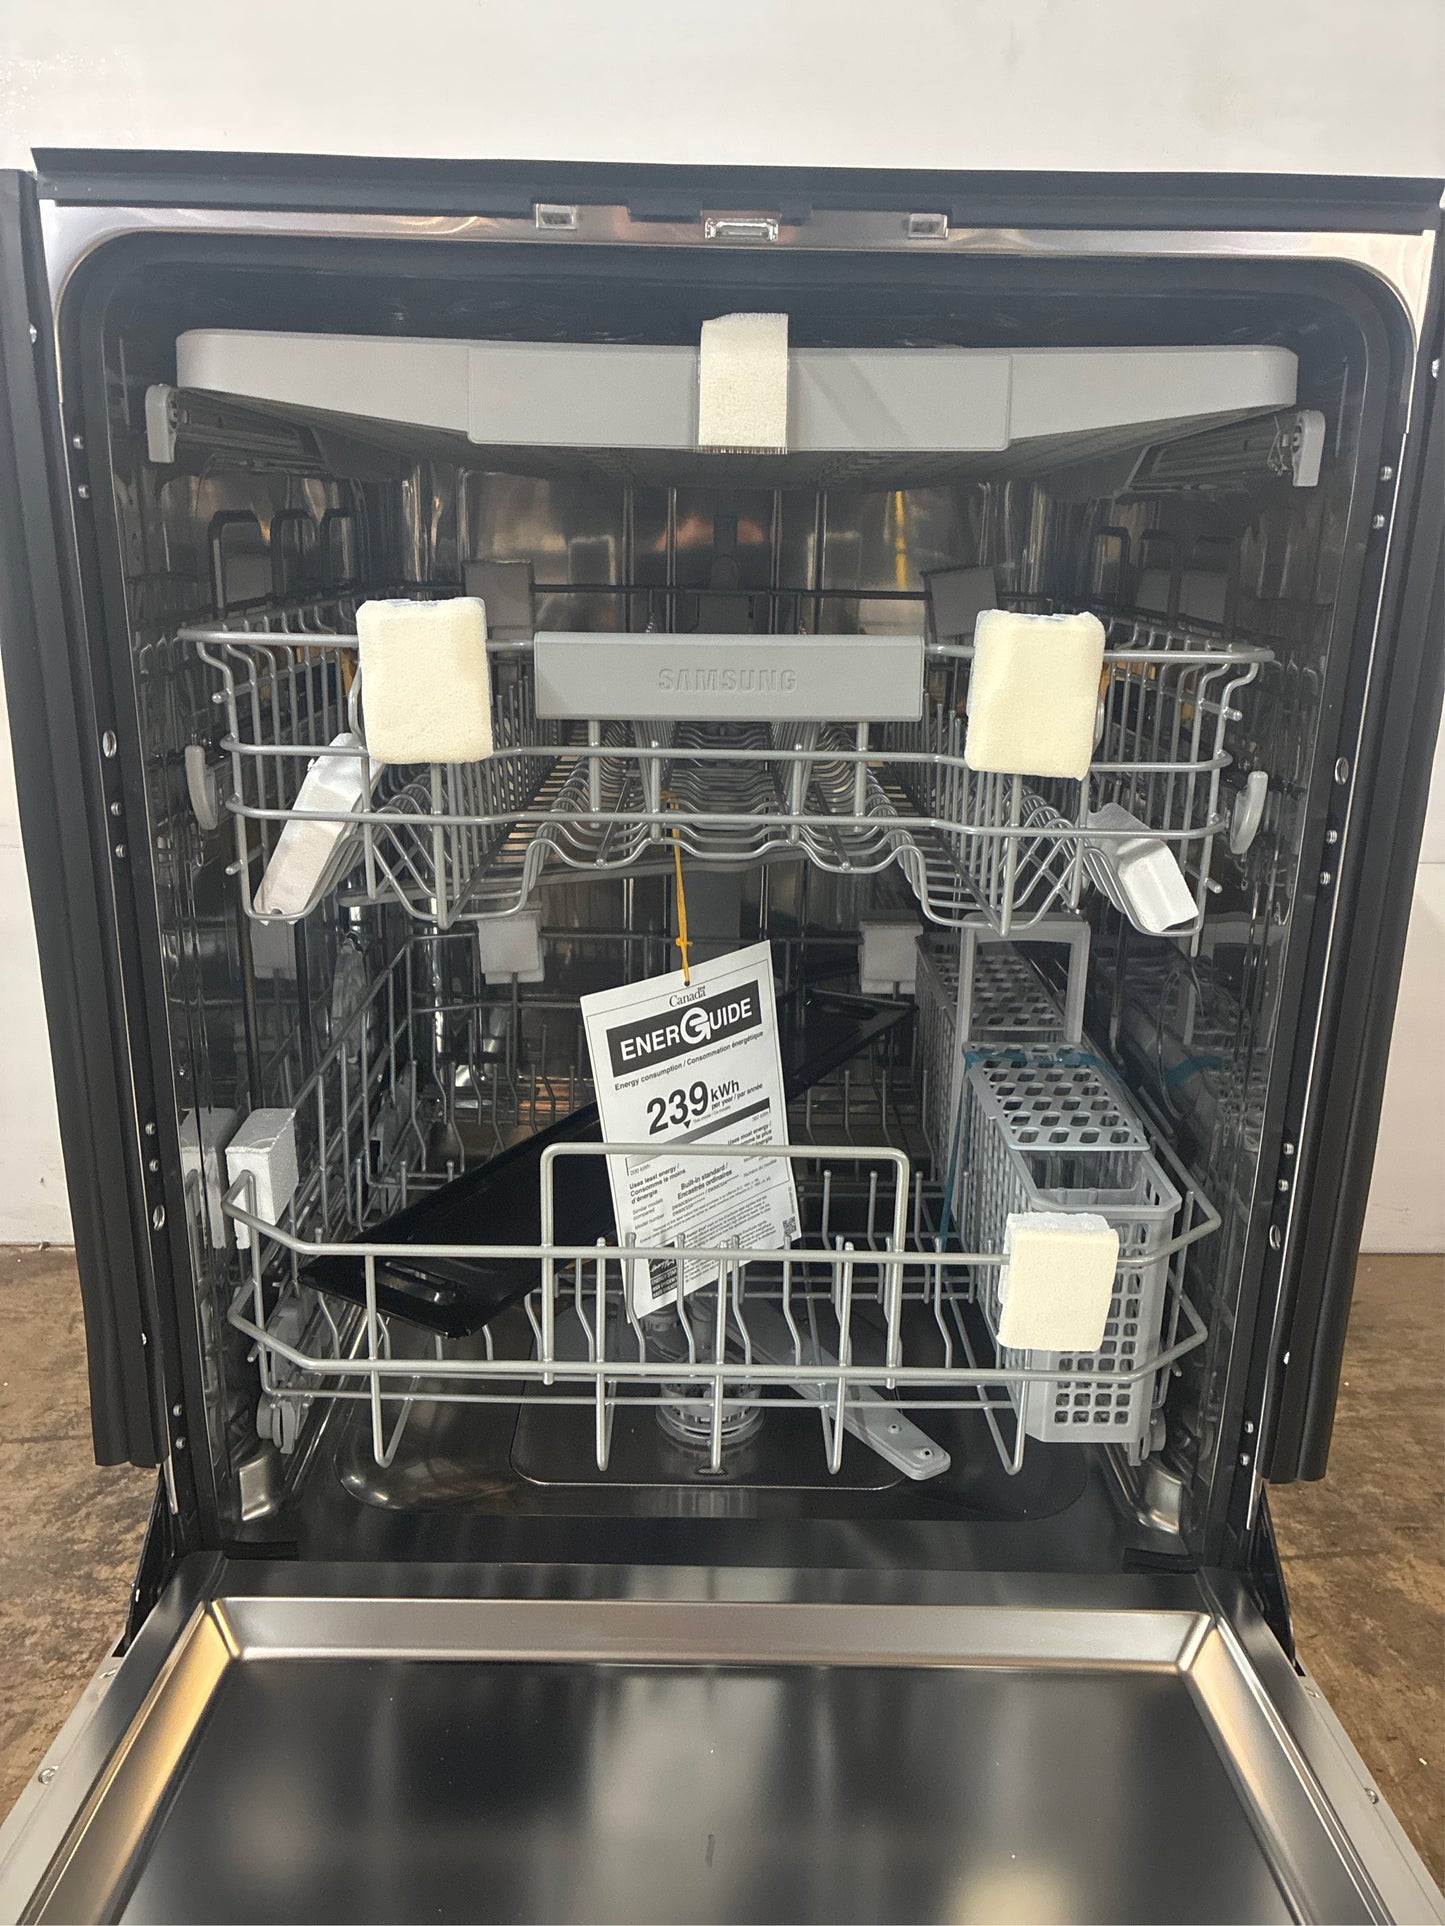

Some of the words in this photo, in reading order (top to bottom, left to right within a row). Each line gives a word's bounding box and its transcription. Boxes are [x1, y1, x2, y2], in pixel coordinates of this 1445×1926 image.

[658, 667, 797, 692] SAMSUNG
[669, 986, 706, 1007] Canada
[620, 998, 752, 1061] ENERGUIDE
[614, 1078, 640, 1091] Energy
[641, 1062, 683, 1082] consumption
[686, 1043, 731, 1066] Consommation
[731, 1031, 764, 1048] énergétique
[647, 1081, 709, 1135] 239
[711, 1079, 740, 1102] kWh
[712, 1102, 721, 1111] per
[721, 1096, 733, 1106] year
[737, 1090, 746, 1100] par
[746, 1083, 763, 1095] année
[630, 1180, 644, 1190] Uses
[644, 1173, 658, 1183] least
[658, 1165, 676, 1178] energy
[630, 1179, 663, 1197] Consomme
[669, 1169, 686, 1180] moins
[677, 1182, 705, 1200] Encastrés
[705, 1169, 732, 1187] ordinaires
[680, 1176, 701, 1190] Built-in
[701, 1163, 726, 1181] standard
[631, 1189, 658, 1205] d'énergie
